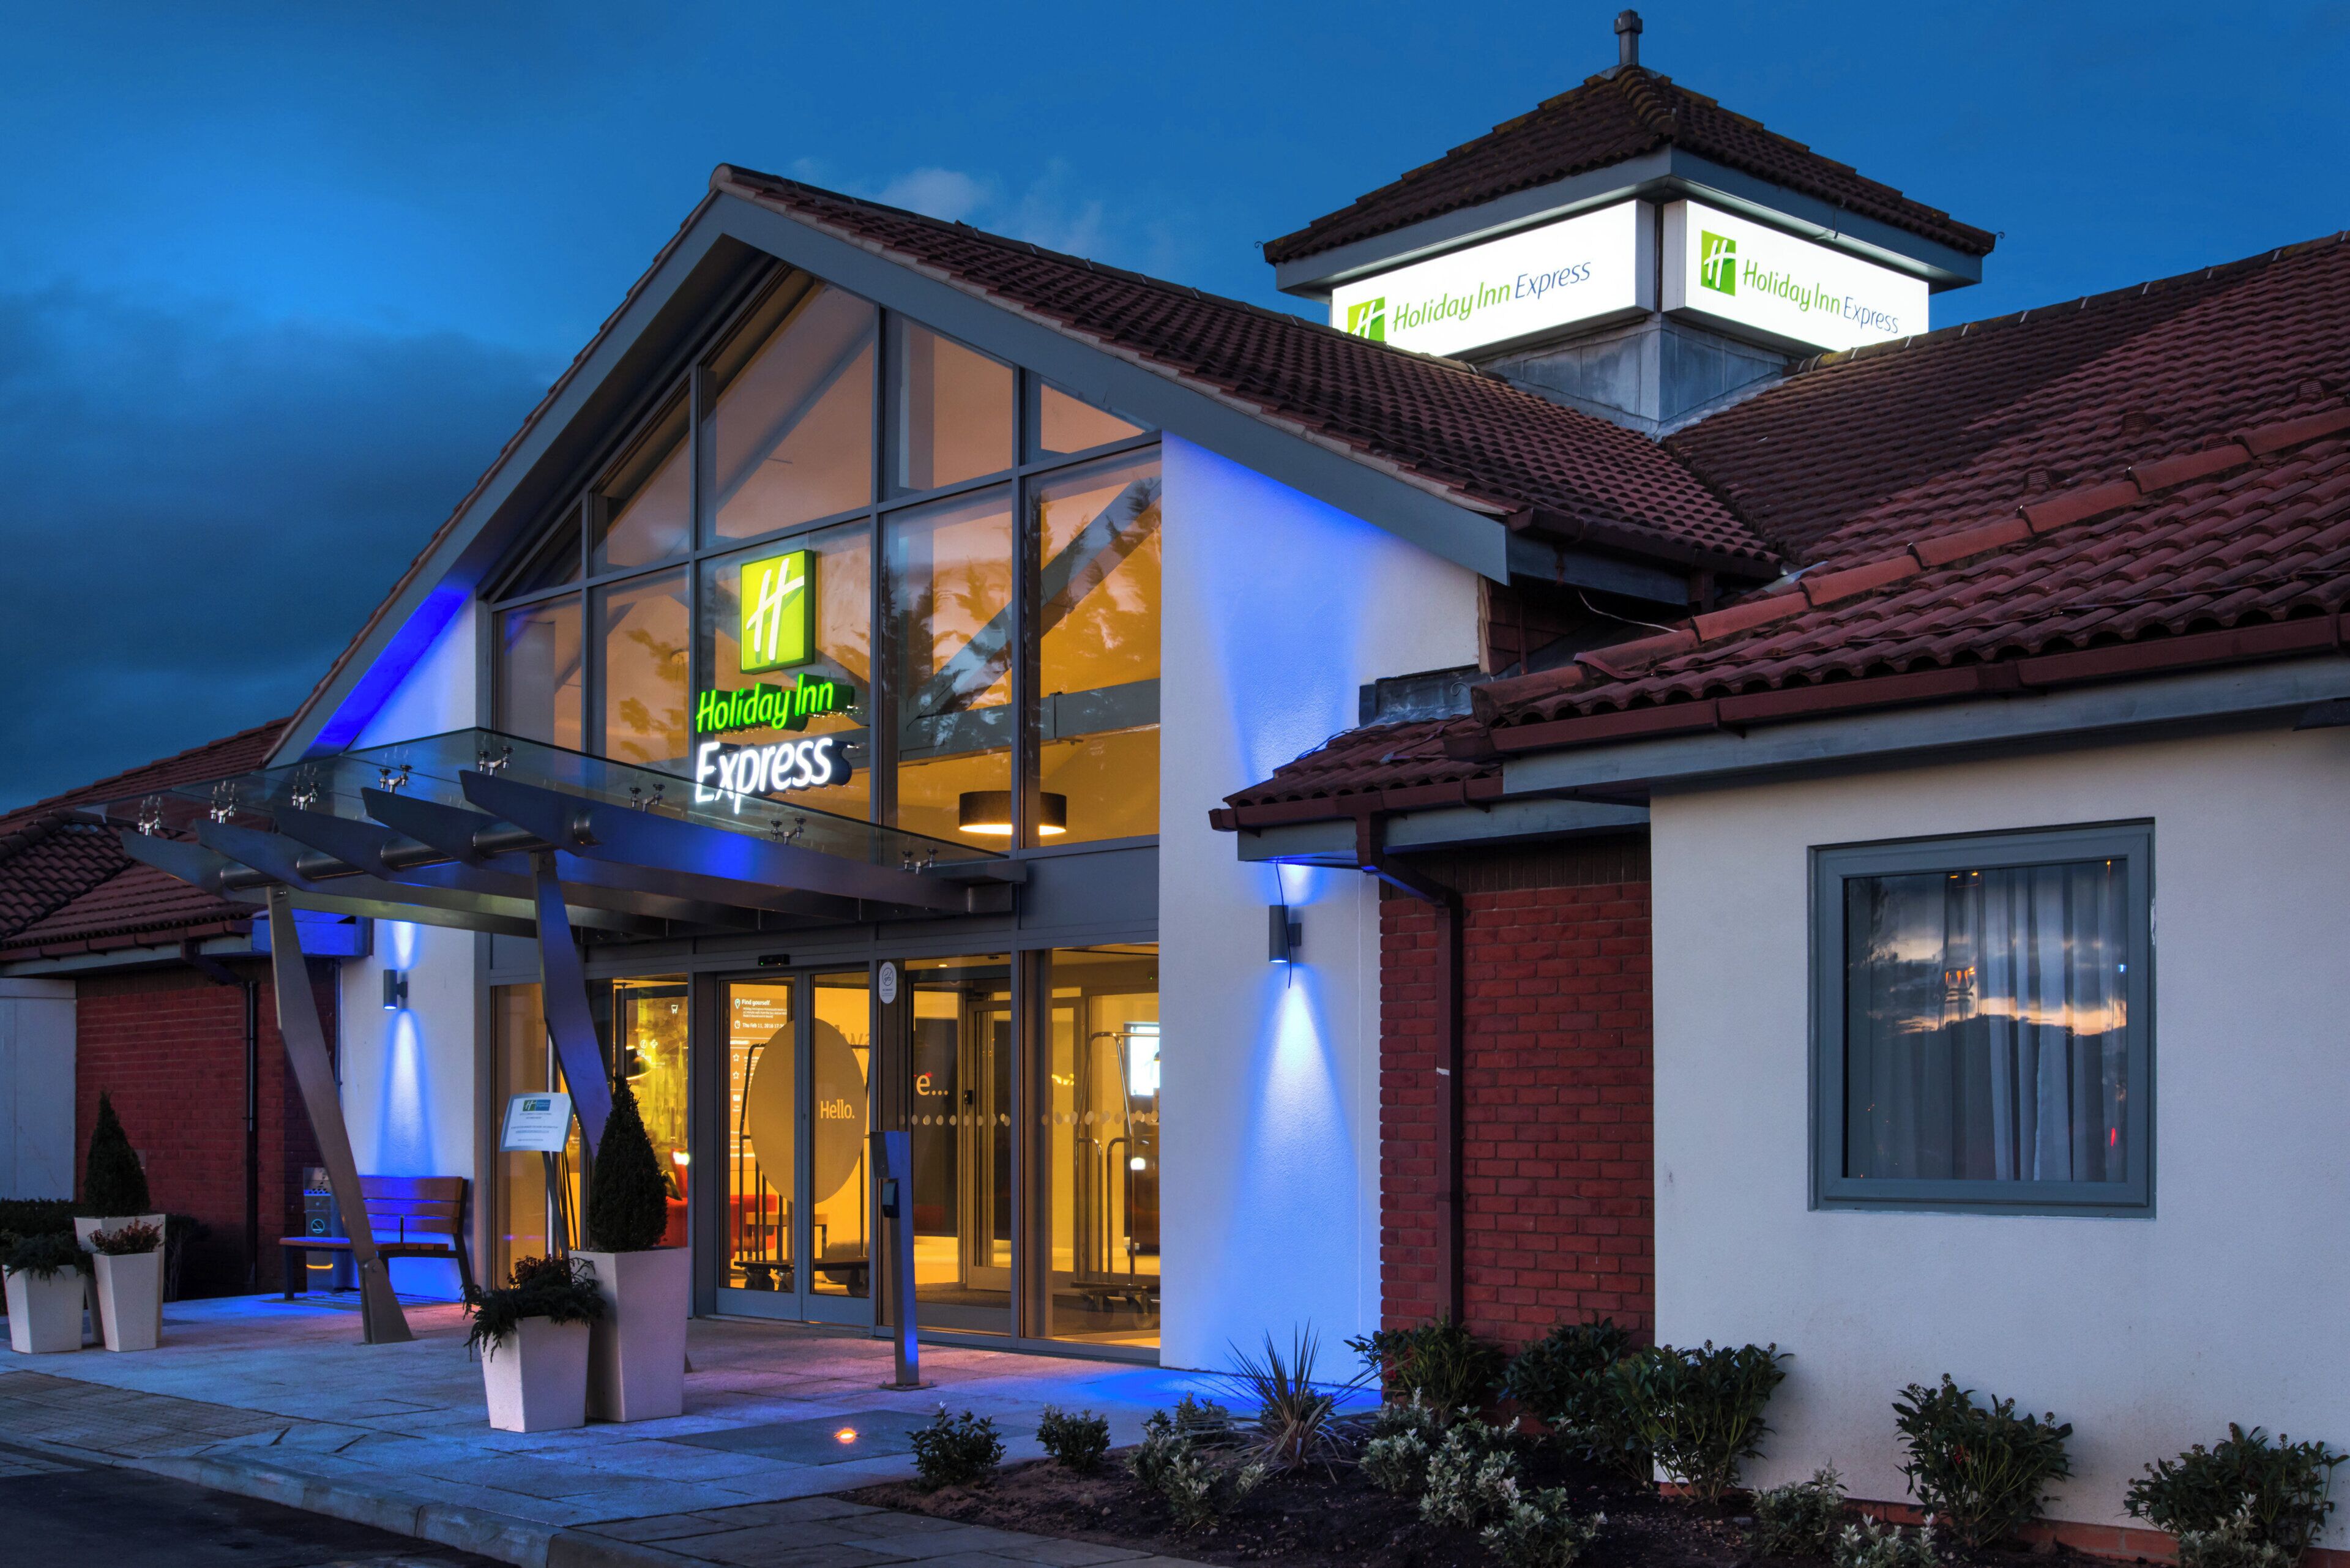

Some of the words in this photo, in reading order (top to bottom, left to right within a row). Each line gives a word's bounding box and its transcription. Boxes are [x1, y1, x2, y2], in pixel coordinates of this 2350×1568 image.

[1392, 293, 1474, 333] Holiday
[1477, 282, 1511, 310] Inn
[1515, 261, 1591, 300] Express
[1742, 259, 1811, 313] Holiday
[1814, 283, 1840, 315] Inn
[1843, 296, 1899, 334] Express
[696, 682, 791, 733] Holiday
[795, 673, 834, 717] Inn
[695, 737, 834, 815] Express
[820, 1099, 855, 1119] Hello.
